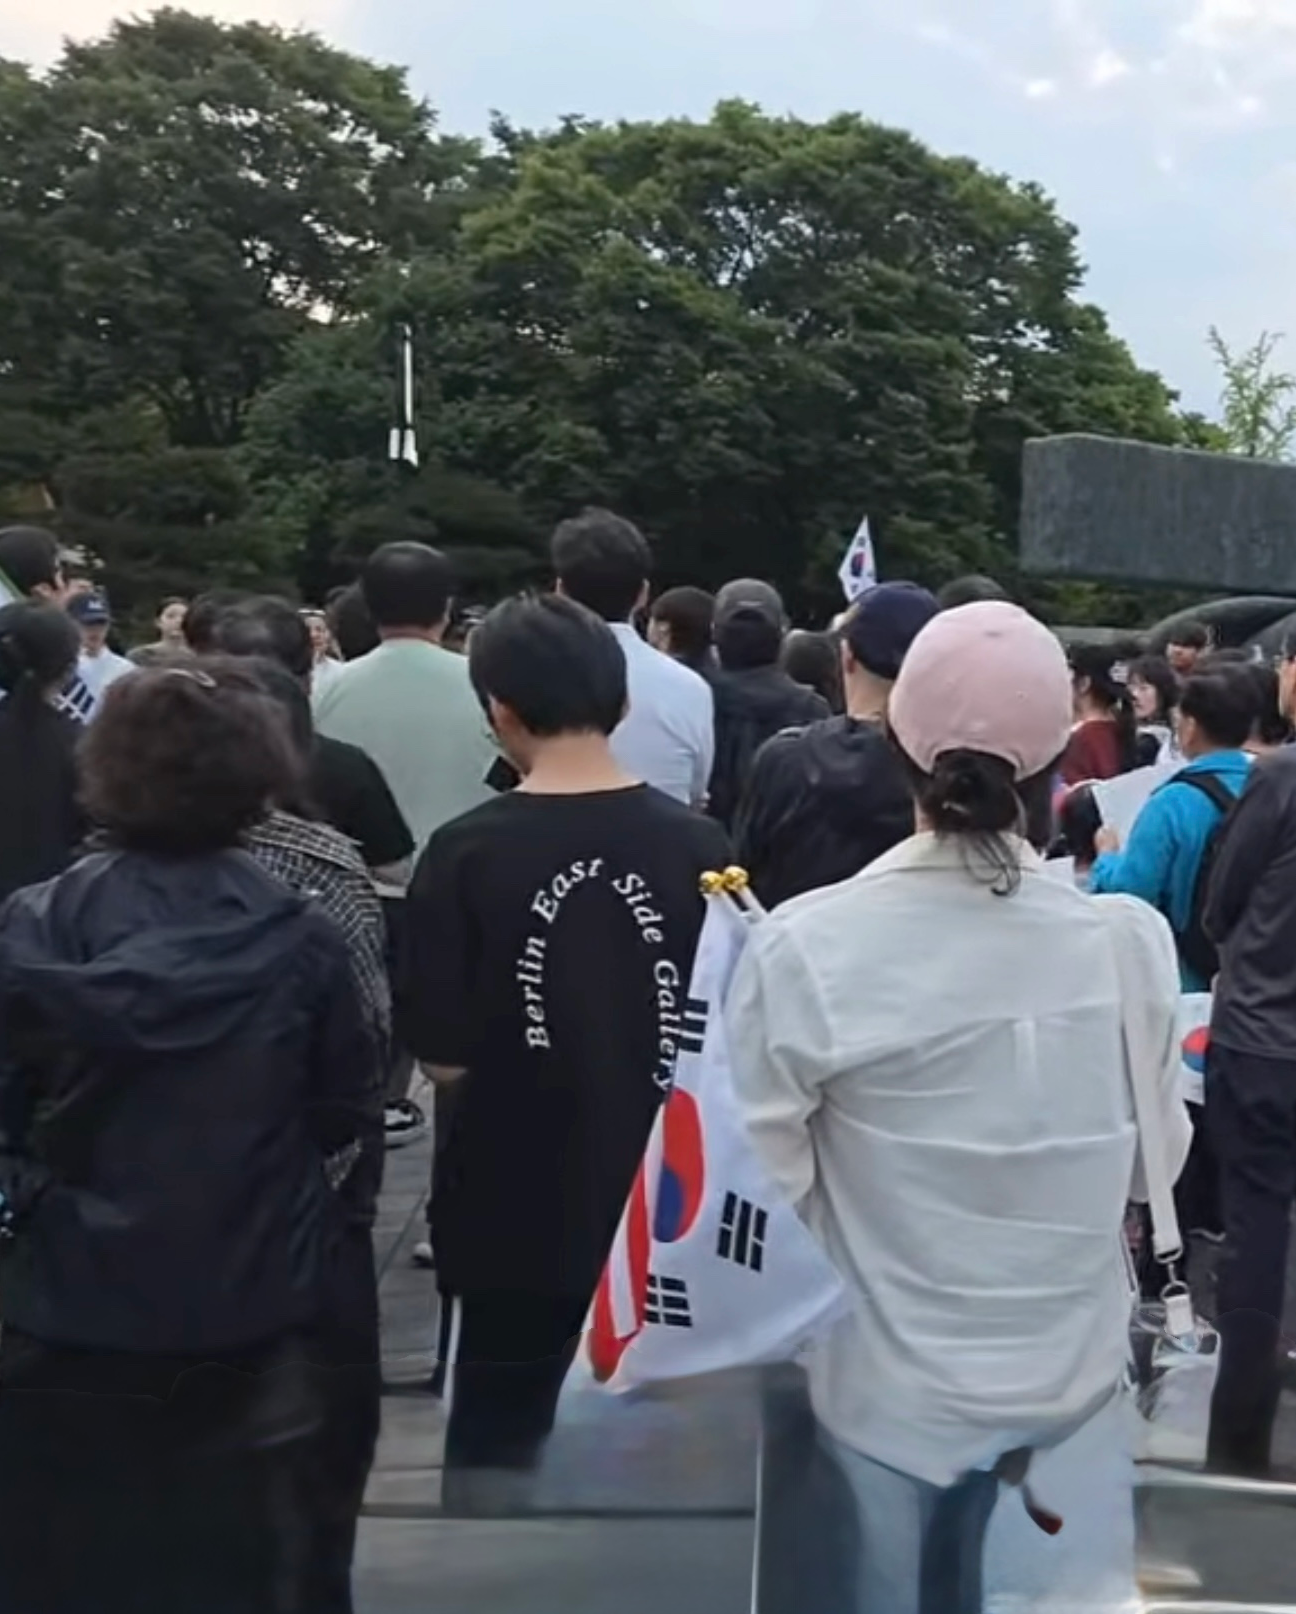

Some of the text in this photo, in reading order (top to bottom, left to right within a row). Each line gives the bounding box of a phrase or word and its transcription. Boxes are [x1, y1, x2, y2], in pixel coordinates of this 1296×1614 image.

[516, 857, 682, 1091] Berlin East Side Gallery
